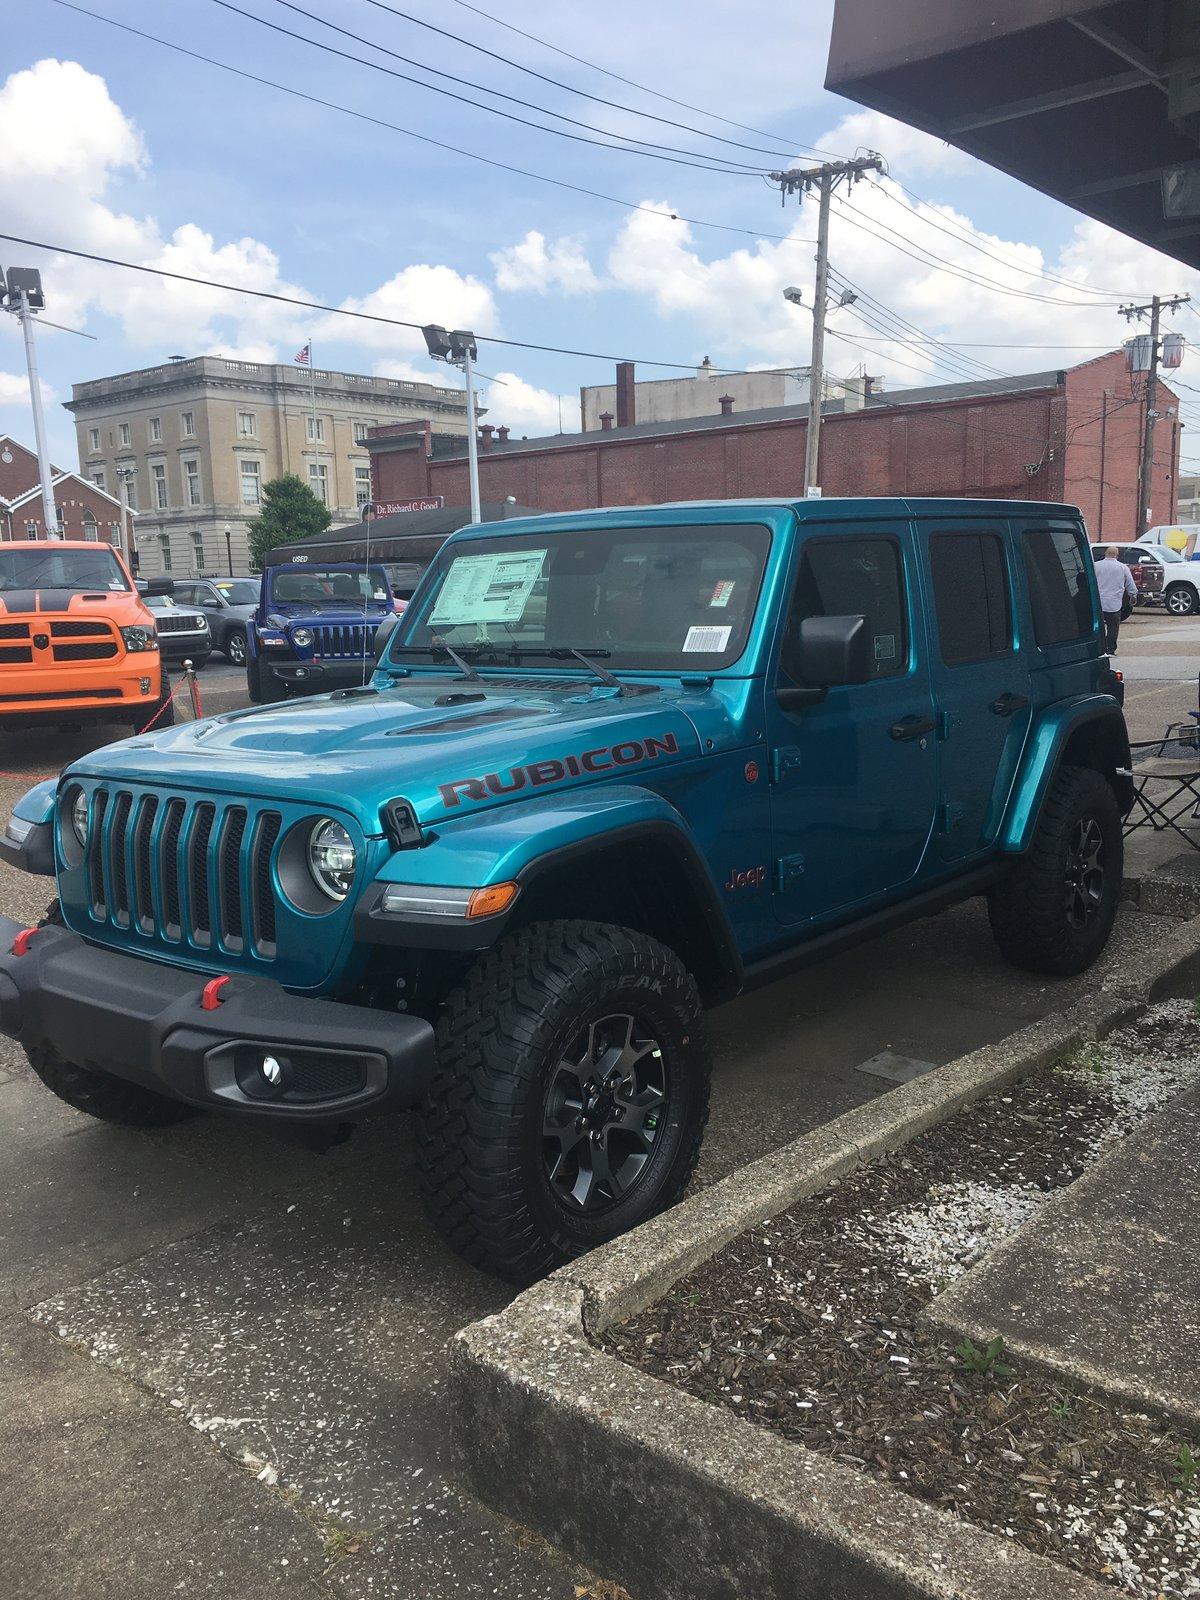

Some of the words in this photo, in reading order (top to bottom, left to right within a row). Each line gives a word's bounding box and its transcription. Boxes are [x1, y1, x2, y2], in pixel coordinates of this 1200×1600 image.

[376, 505, 387, 515] Dr.
[387, 503, 412, 514] Richard
[412, 502, 420, 511] C.
[420, 501, 438, 511] Good
[292, 555, 308, 563] USED
[438, 732, 679, 809] RUBICON
[725, 866, 765, 892] Jeep
